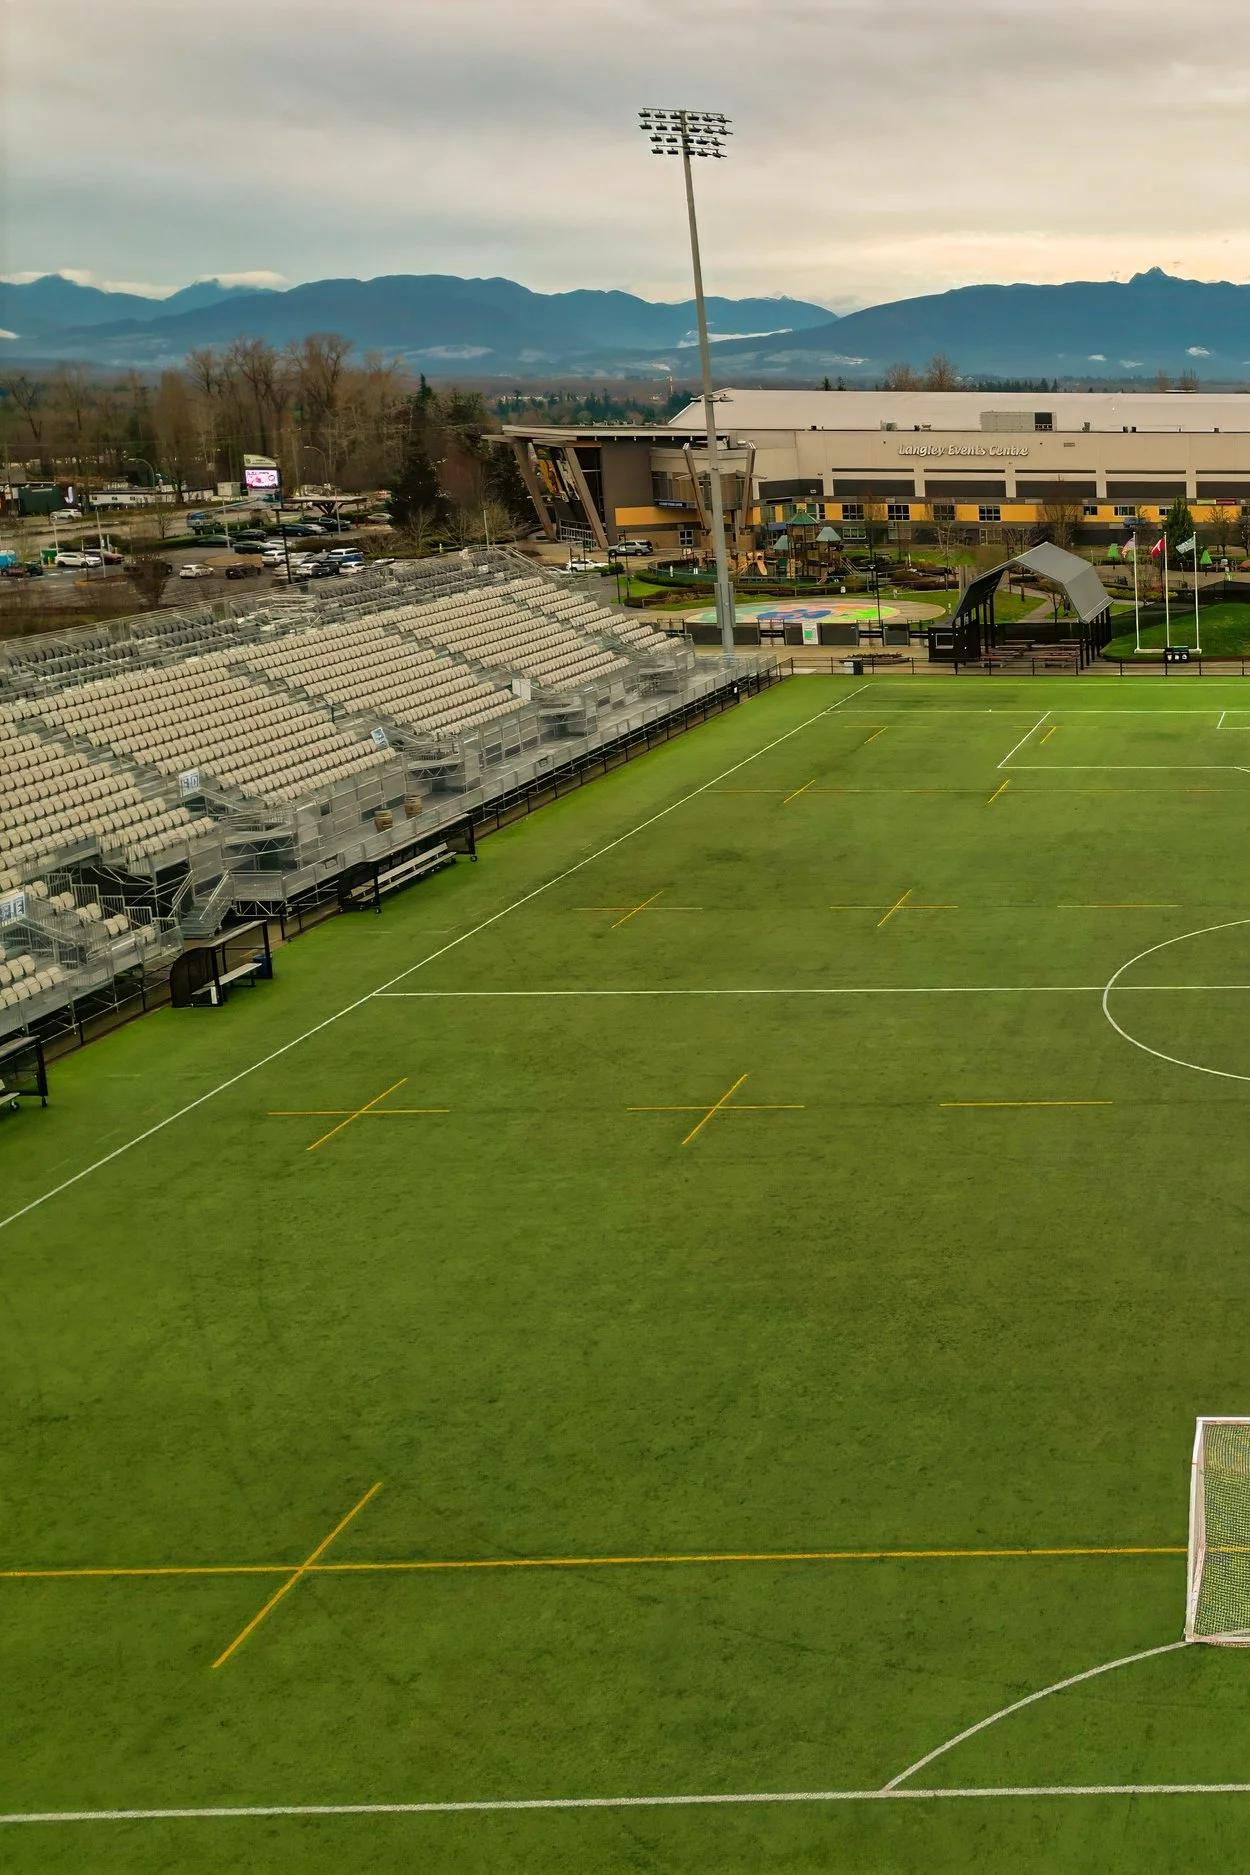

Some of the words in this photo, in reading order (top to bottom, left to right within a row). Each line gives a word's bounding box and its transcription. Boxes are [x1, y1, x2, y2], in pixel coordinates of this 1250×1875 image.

[898, 444, 946, 457] Langley
[947, 444, 986, 456] Events
[988, 445, 1029, 457] Centre
